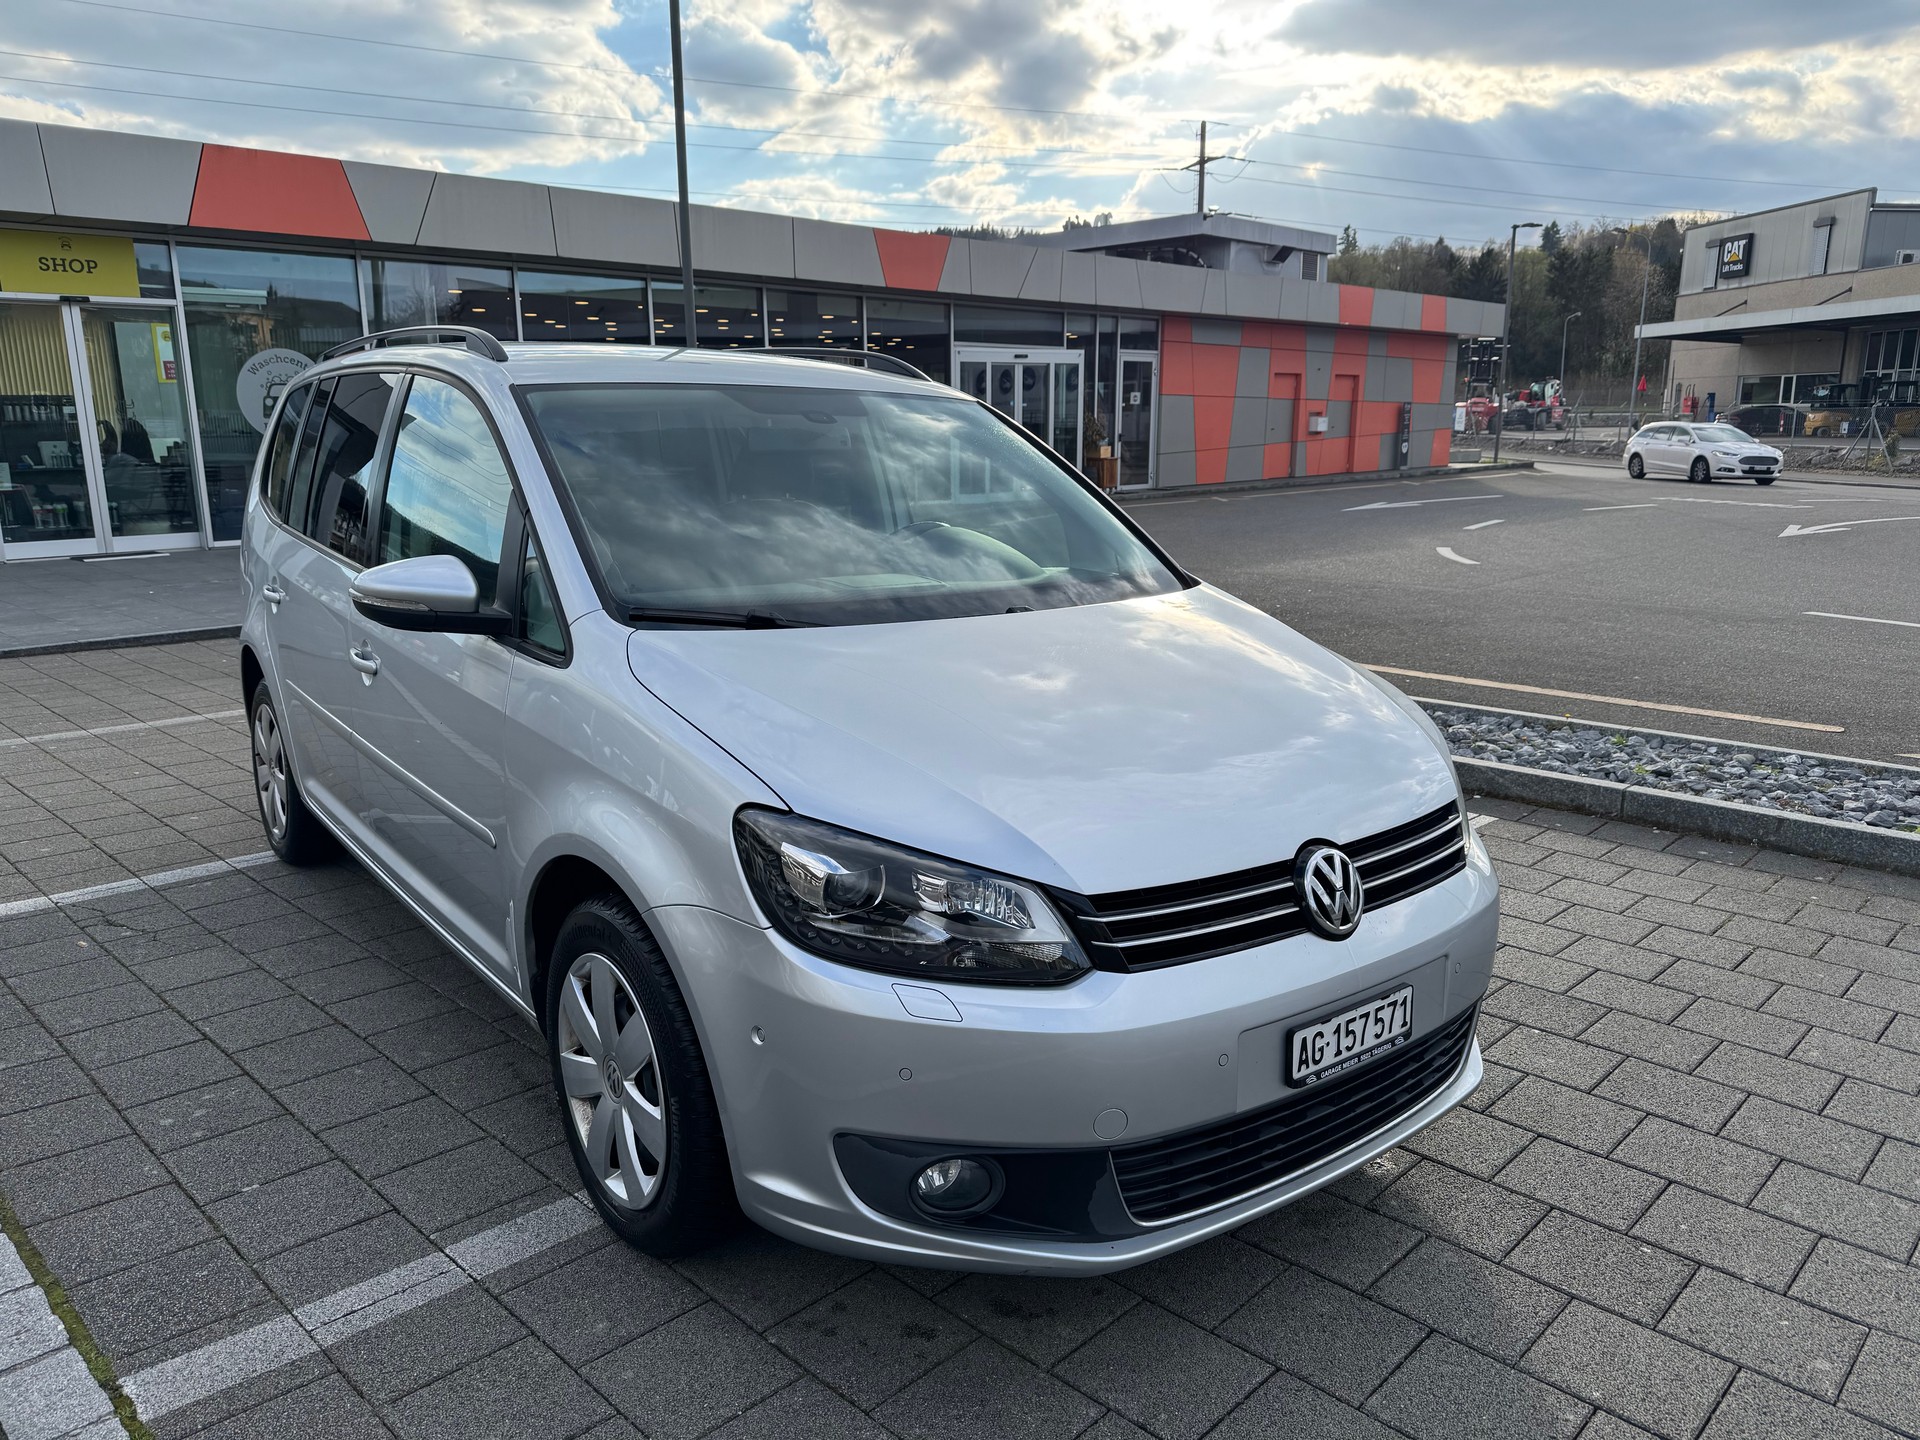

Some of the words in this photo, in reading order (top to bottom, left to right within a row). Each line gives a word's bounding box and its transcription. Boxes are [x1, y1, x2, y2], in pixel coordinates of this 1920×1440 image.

[1723, 240, 1746, 262] CAT
[38, 256, 98, 274] SHOP
[247, 354, 308, 376] Waschcent
[1320, 1064, 1342, 1079] GARAGE
